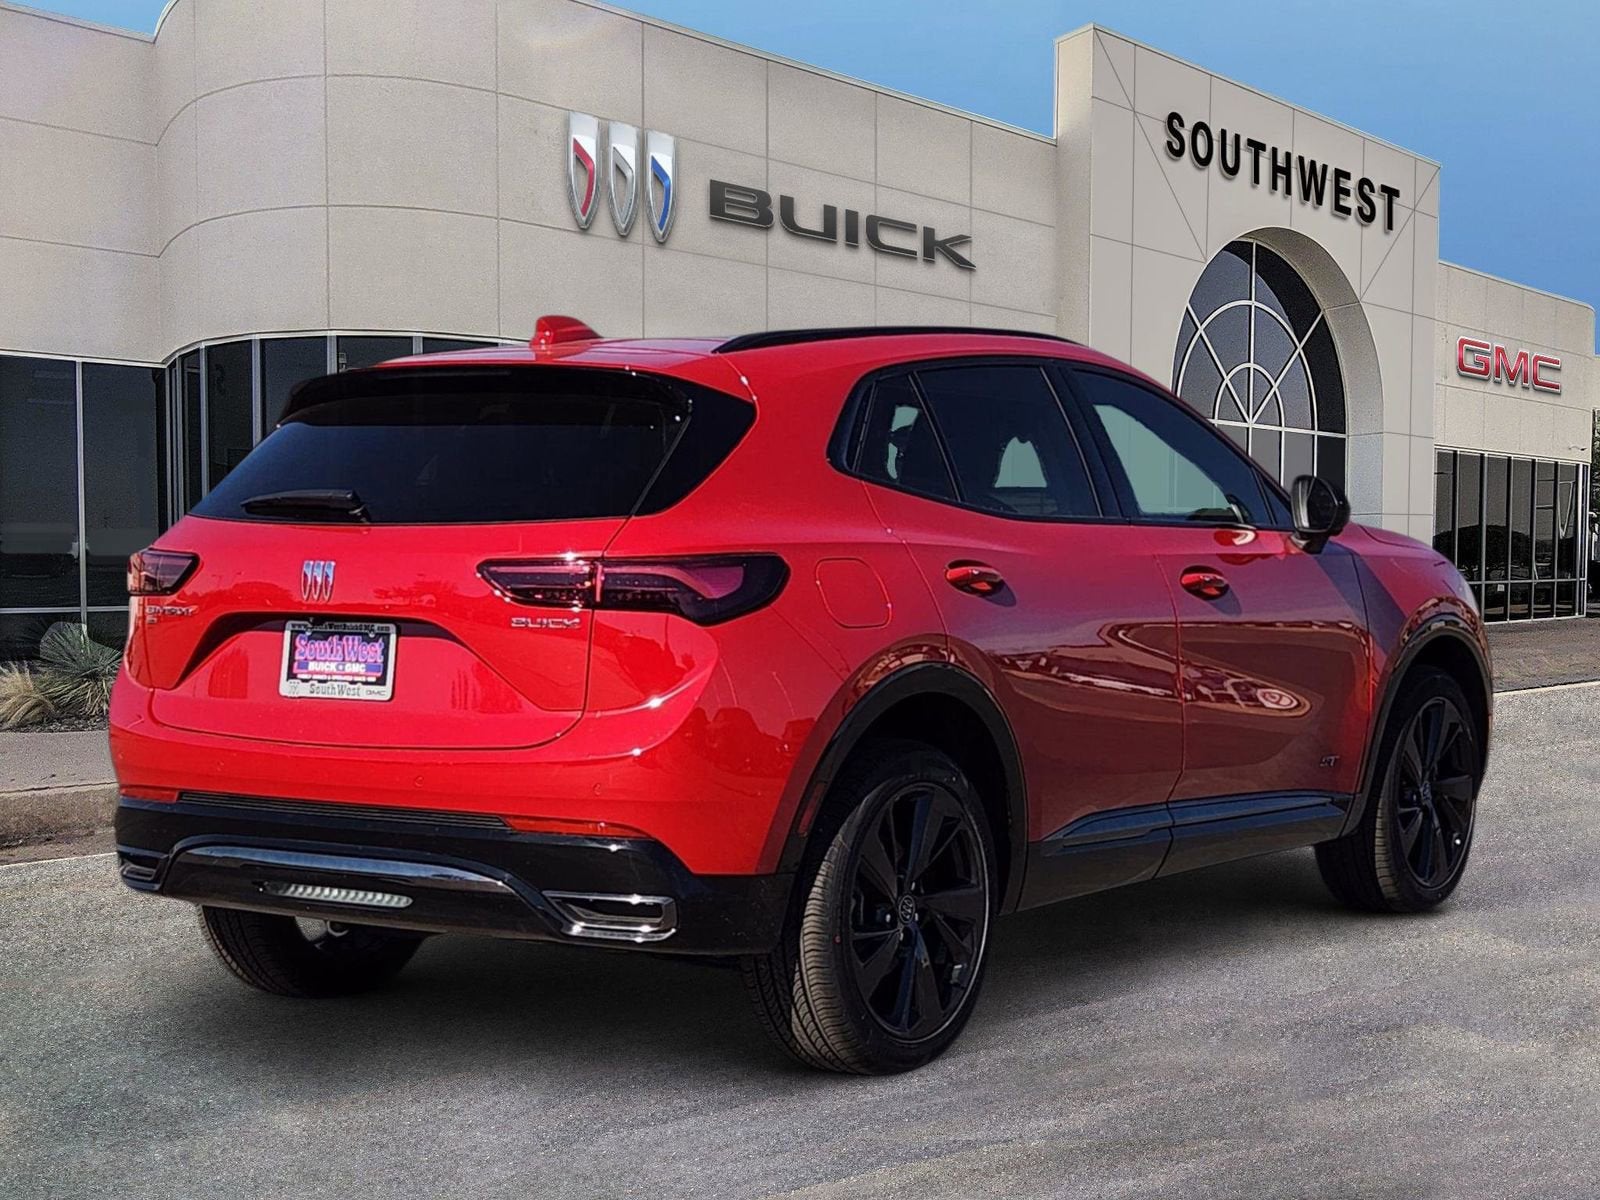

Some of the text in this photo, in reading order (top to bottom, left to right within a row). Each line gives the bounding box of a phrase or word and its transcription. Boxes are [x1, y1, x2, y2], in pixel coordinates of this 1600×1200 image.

[1165, 111, 1400, 231] SOUTHWEST
[709, 179, 977, 270] BUICK
[1457, 336, 1562, 395] GMC
[511, 617, 581, 629] BUICK
[294, 633, 385, 663] SouthWest
[307, 660, 367, 674] BUICK GMC
[309, 683, 362, 698] SouthWest
